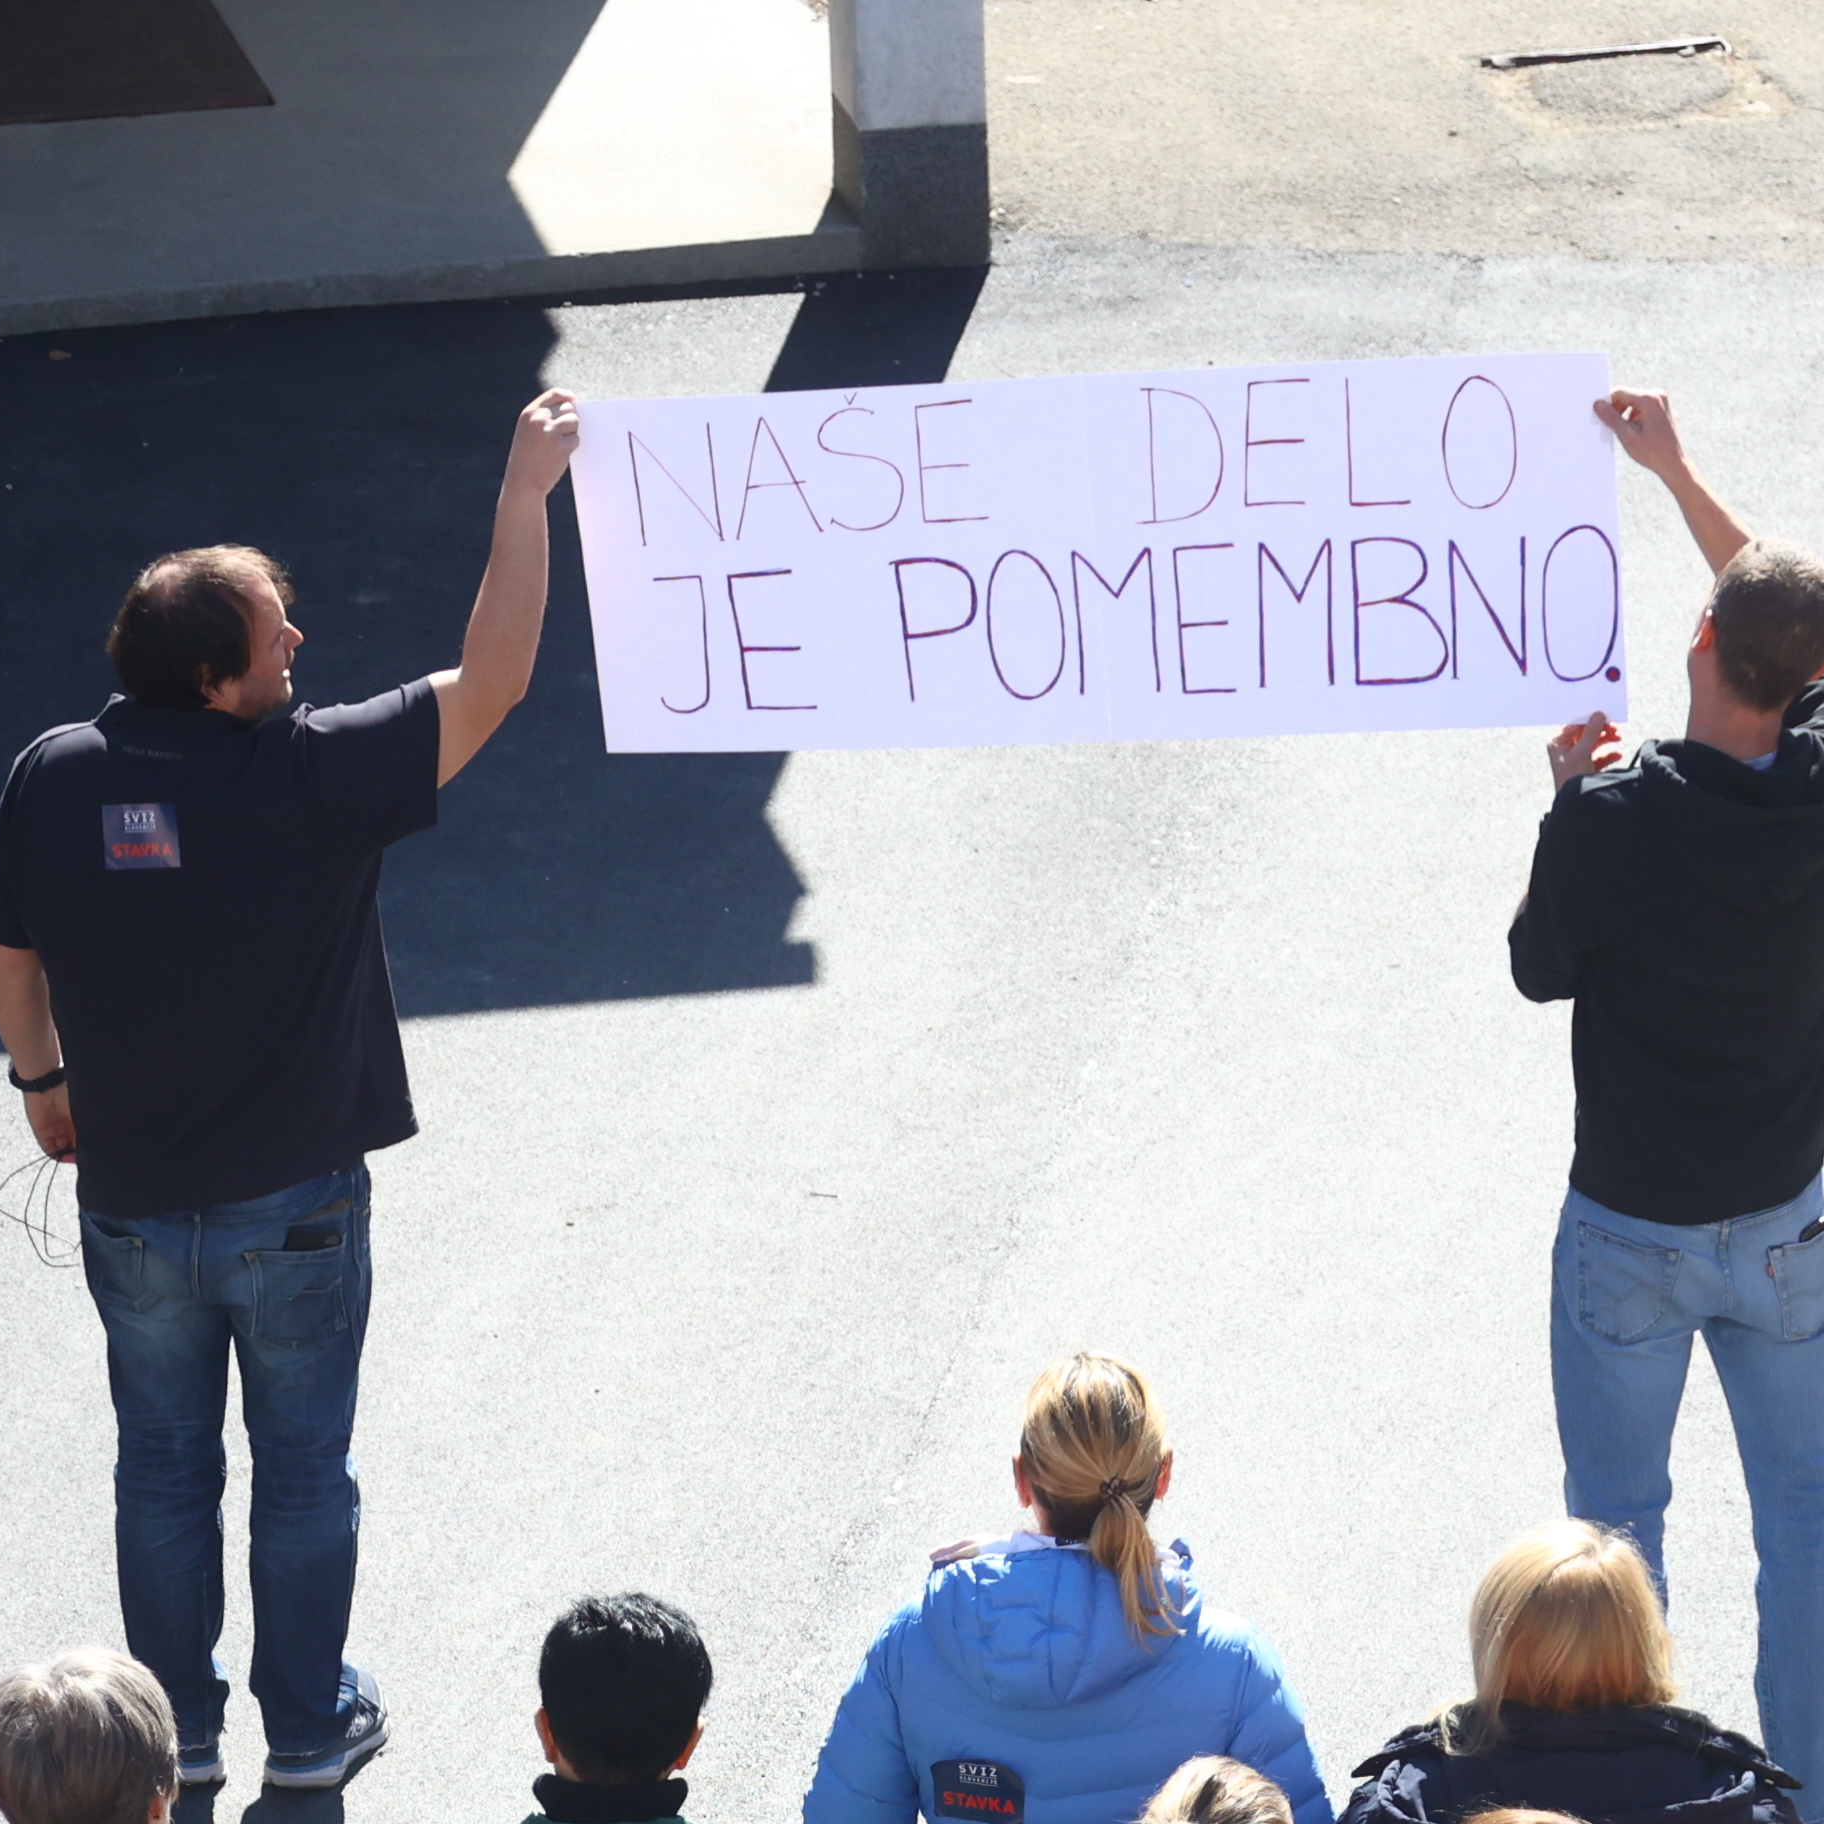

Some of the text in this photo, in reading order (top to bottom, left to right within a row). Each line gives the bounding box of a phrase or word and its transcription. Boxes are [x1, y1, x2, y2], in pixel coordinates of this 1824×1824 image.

[627, 375, 1517, 547] NAŠE DELO
[652, 524, 1622, 715] JE POMEMBNO.
[124, 811, 155, 823] SVIZ
[112, 842, 173, 858] STAVKA
[958, 1764, 998, 1777] SVIZ
[942, 1791, 1015, 1814] STAVKA
